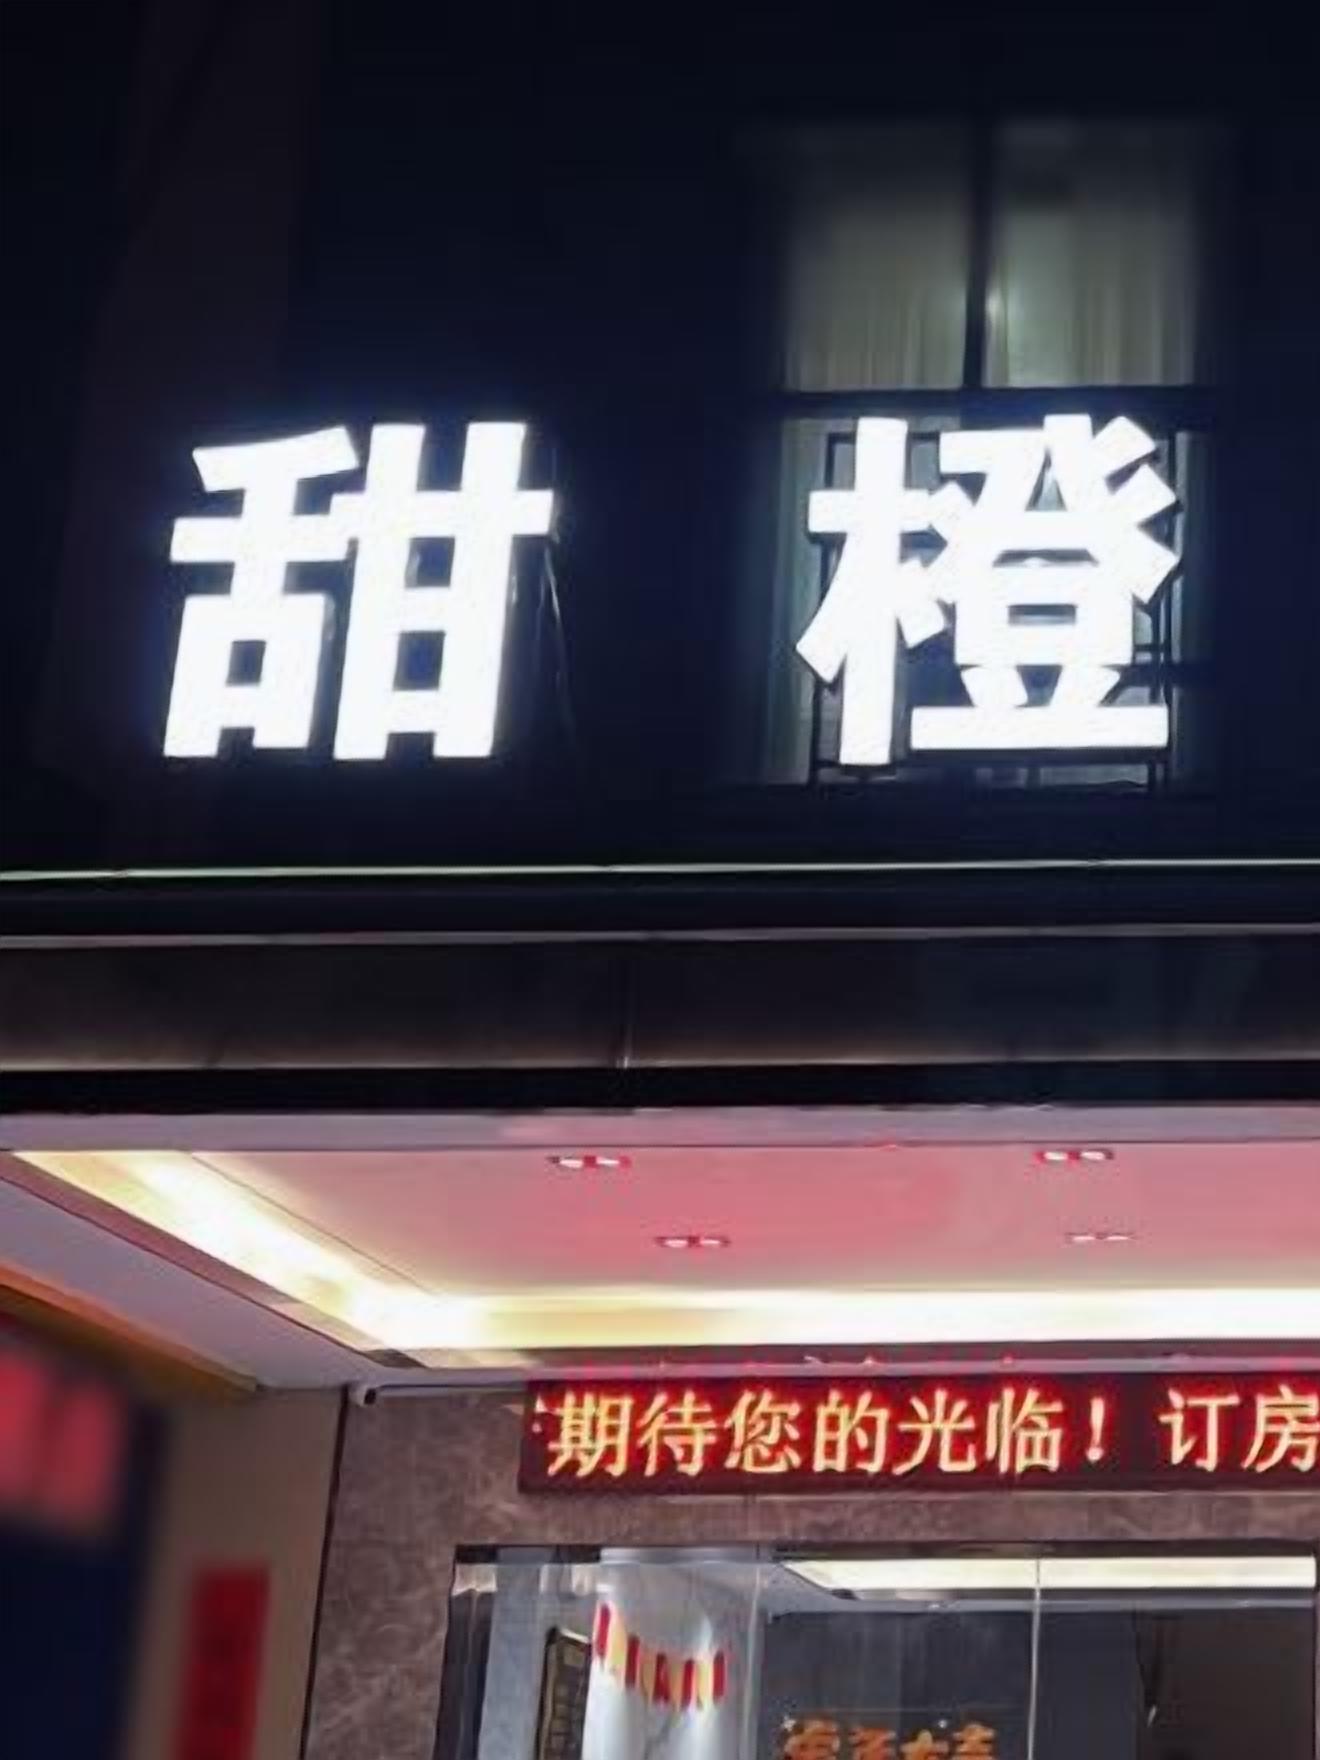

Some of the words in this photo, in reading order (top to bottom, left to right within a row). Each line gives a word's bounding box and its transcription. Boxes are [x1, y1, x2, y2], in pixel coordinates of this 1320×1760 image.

[532, 1387, 1106, 1477] 期待您的光临！
